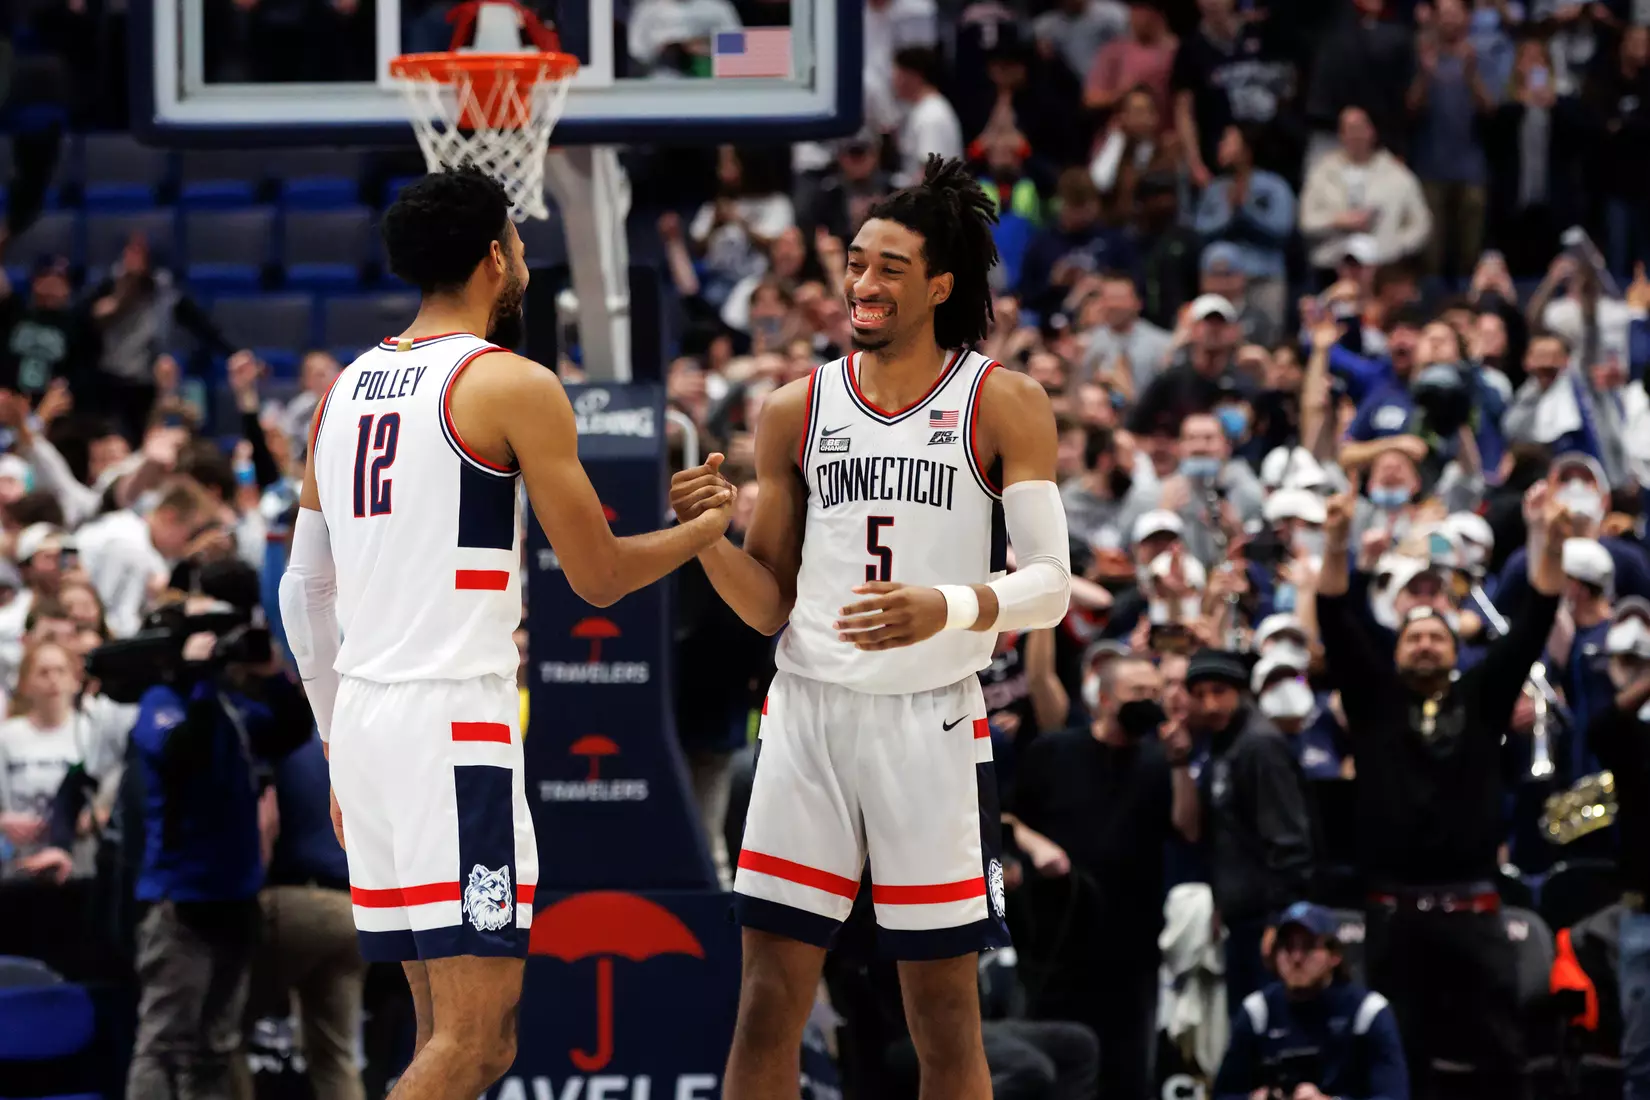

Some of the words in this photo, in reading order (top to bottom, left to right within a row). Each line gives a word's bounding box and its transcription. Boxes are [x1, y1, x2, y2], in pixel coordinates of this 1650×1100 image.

[352, 366, 428, 401] POLLEY
[353, 412, 401, 518] 12
[816, 456, 958, 511] CONNECTICUT
[865, 515, 895, 583] 5
[540, 661, 650, 684] TRAVELERS
[539, 779, 649, 801] TRAVELERS
